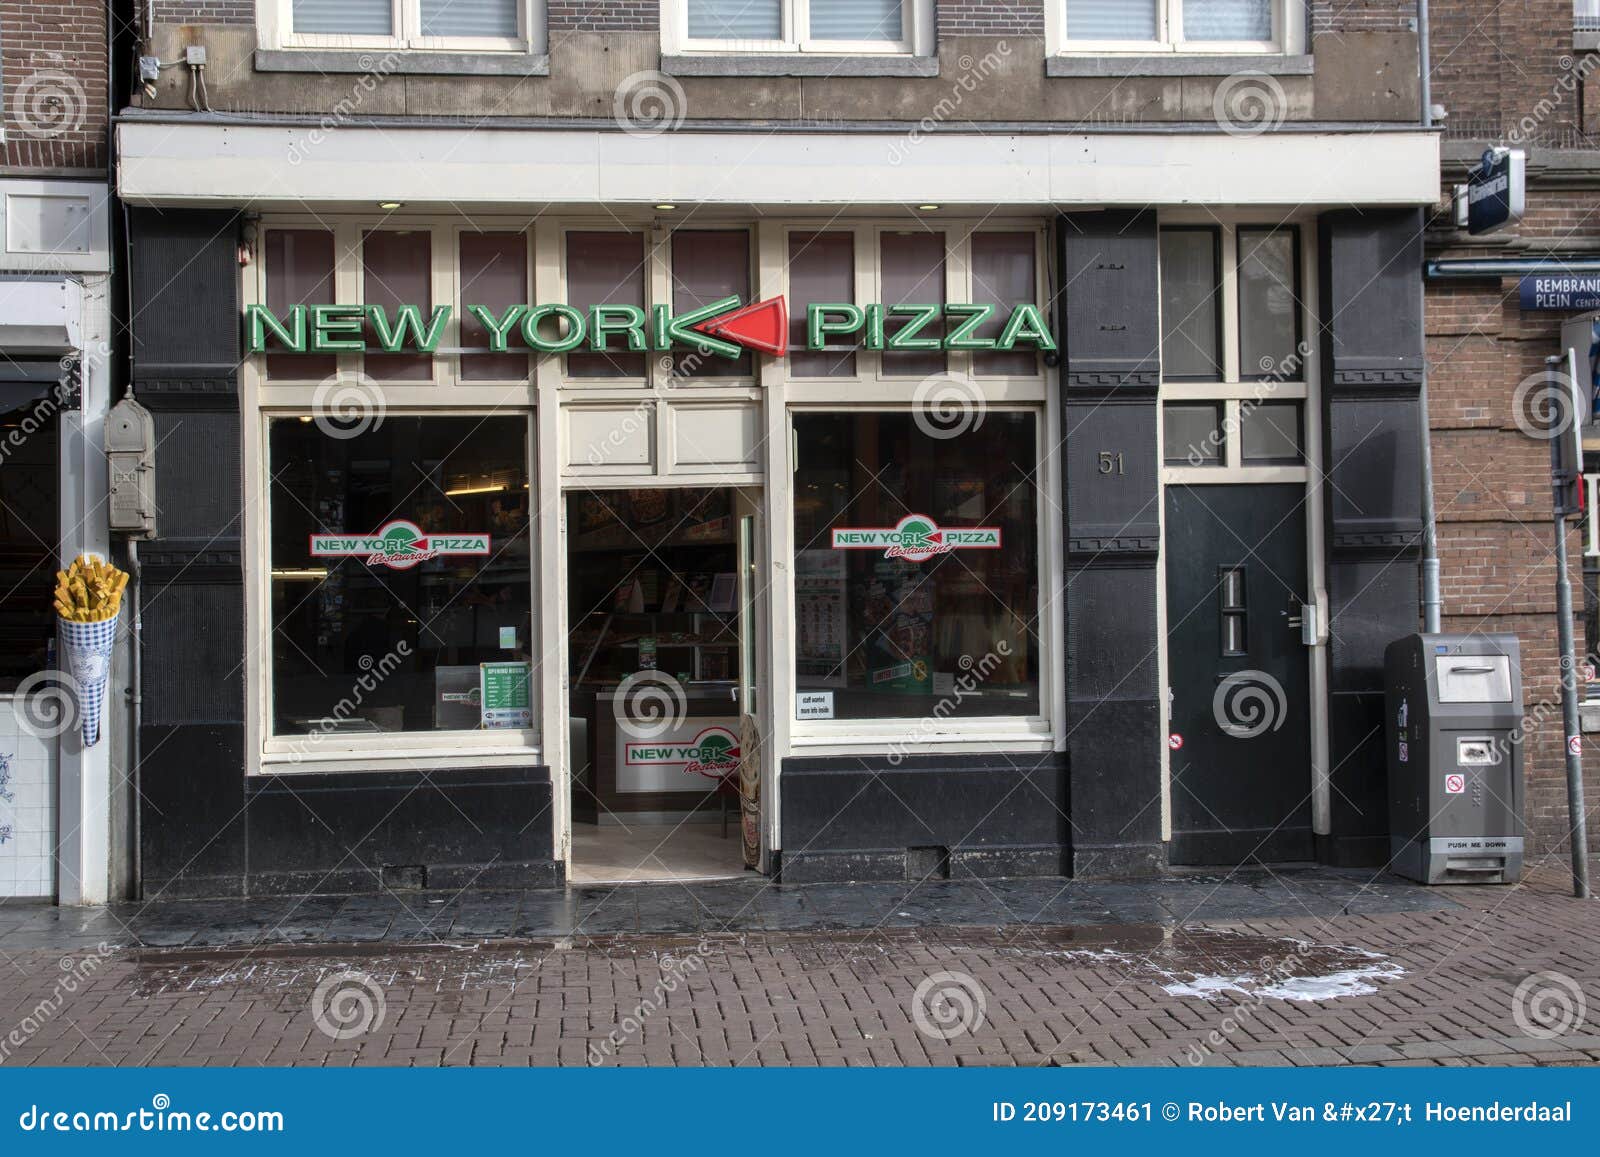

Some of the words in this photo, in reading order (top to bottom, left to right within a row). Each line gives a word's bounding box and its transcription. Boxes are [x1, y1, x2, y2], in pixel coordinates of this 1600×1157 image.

[1536, 294, 1570, 307] PLEIN
[246, 303, 452, 353] NEW
[467, 295, 741, 359] YORK
[807, 303, 1057, 351] PIZZA
[1099, 451, 1125, 475] 51
[316, 539, 358, 550] NEW
[361, 538, 418, 551] YORK
[431, 539, 485, 550] PIZZA
[837, 533, 877, 543] NEW
[880, 532, 934, 545] YORK
[946, 533, 997, 543] PIZZA
[886, 543, 952, 557] Restaurant
[367, 551, 438, 564] Restaurant
[631, 748, 673, 759] NEW
[675, 746, 734, 761] YORK
